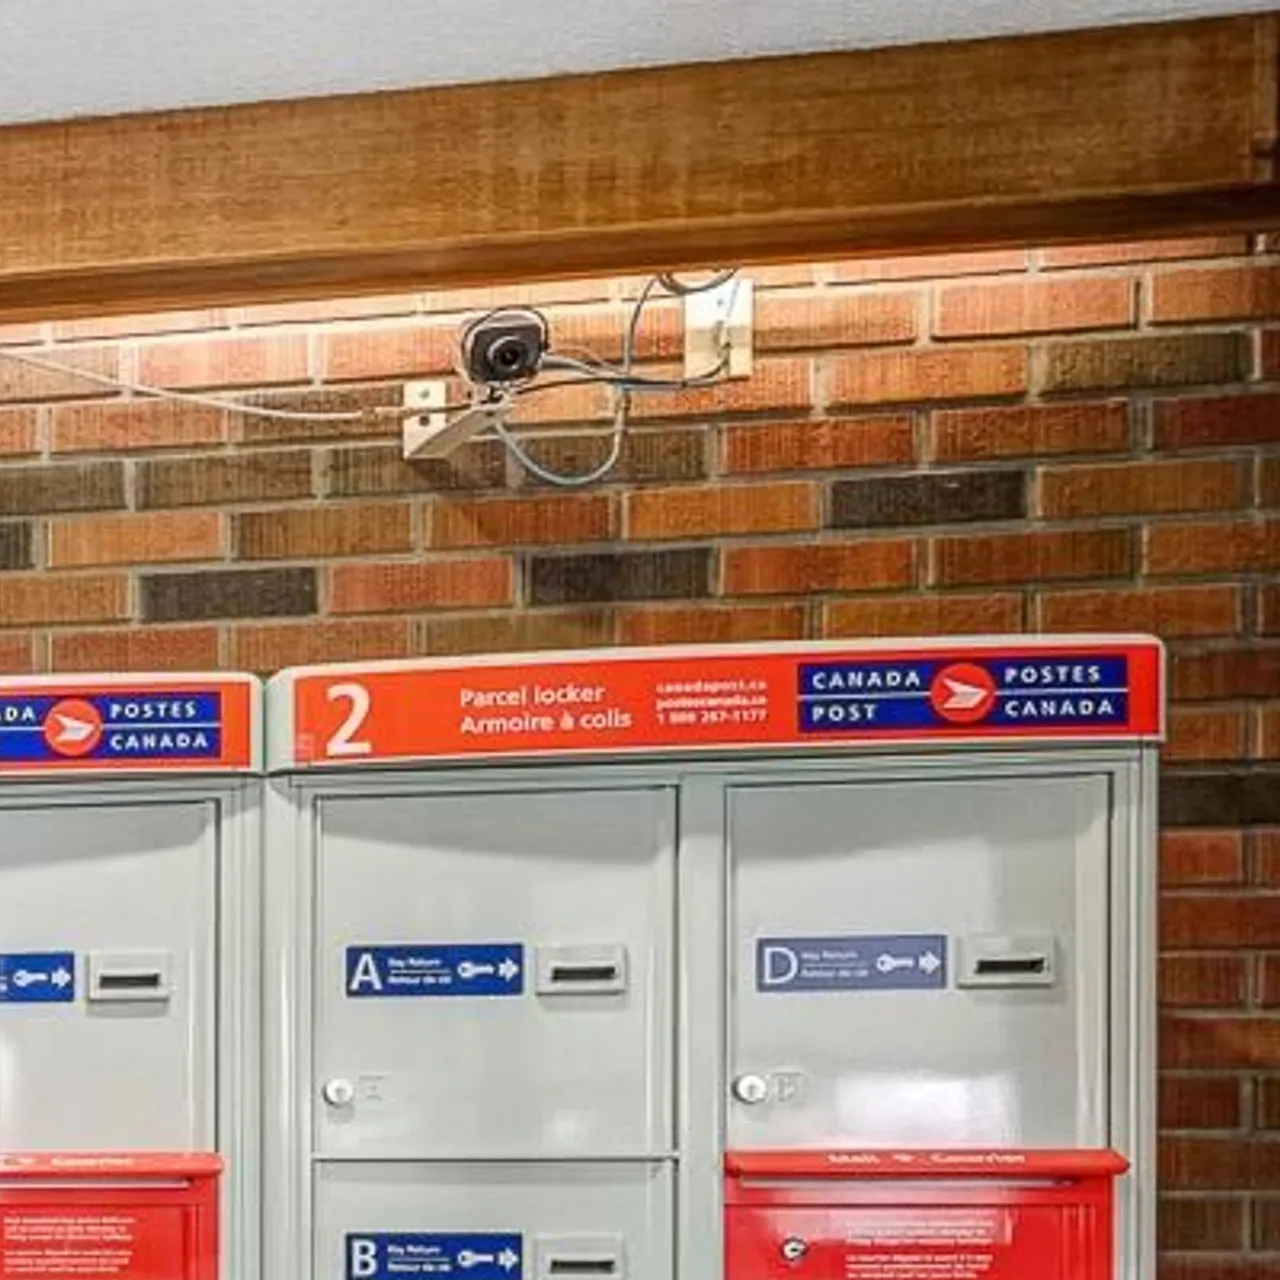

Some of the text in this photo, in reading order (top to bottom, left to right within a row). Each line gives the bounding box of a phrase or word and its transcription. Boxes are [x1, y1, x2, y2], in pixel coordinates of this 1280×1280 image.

[812, 671, 920, 690] CANADA
[1004, 666, 1100, 684] POSTES
[460, 684, 605, 707] Parcel locker
[109, 701, 197, 719] POSTES
[812, 704, 877, 722] POST
[1004, 699, 1114, 717] CANADA
[326, 684, 371, 756] 2
[460, 708, 632, 734] Armoire à colis
[109, 732, 209, 751] CANADA
[349, 953, 383, 990] A
[763, 946, 798, 985] D
[351, 1239, 378, 1276] B
